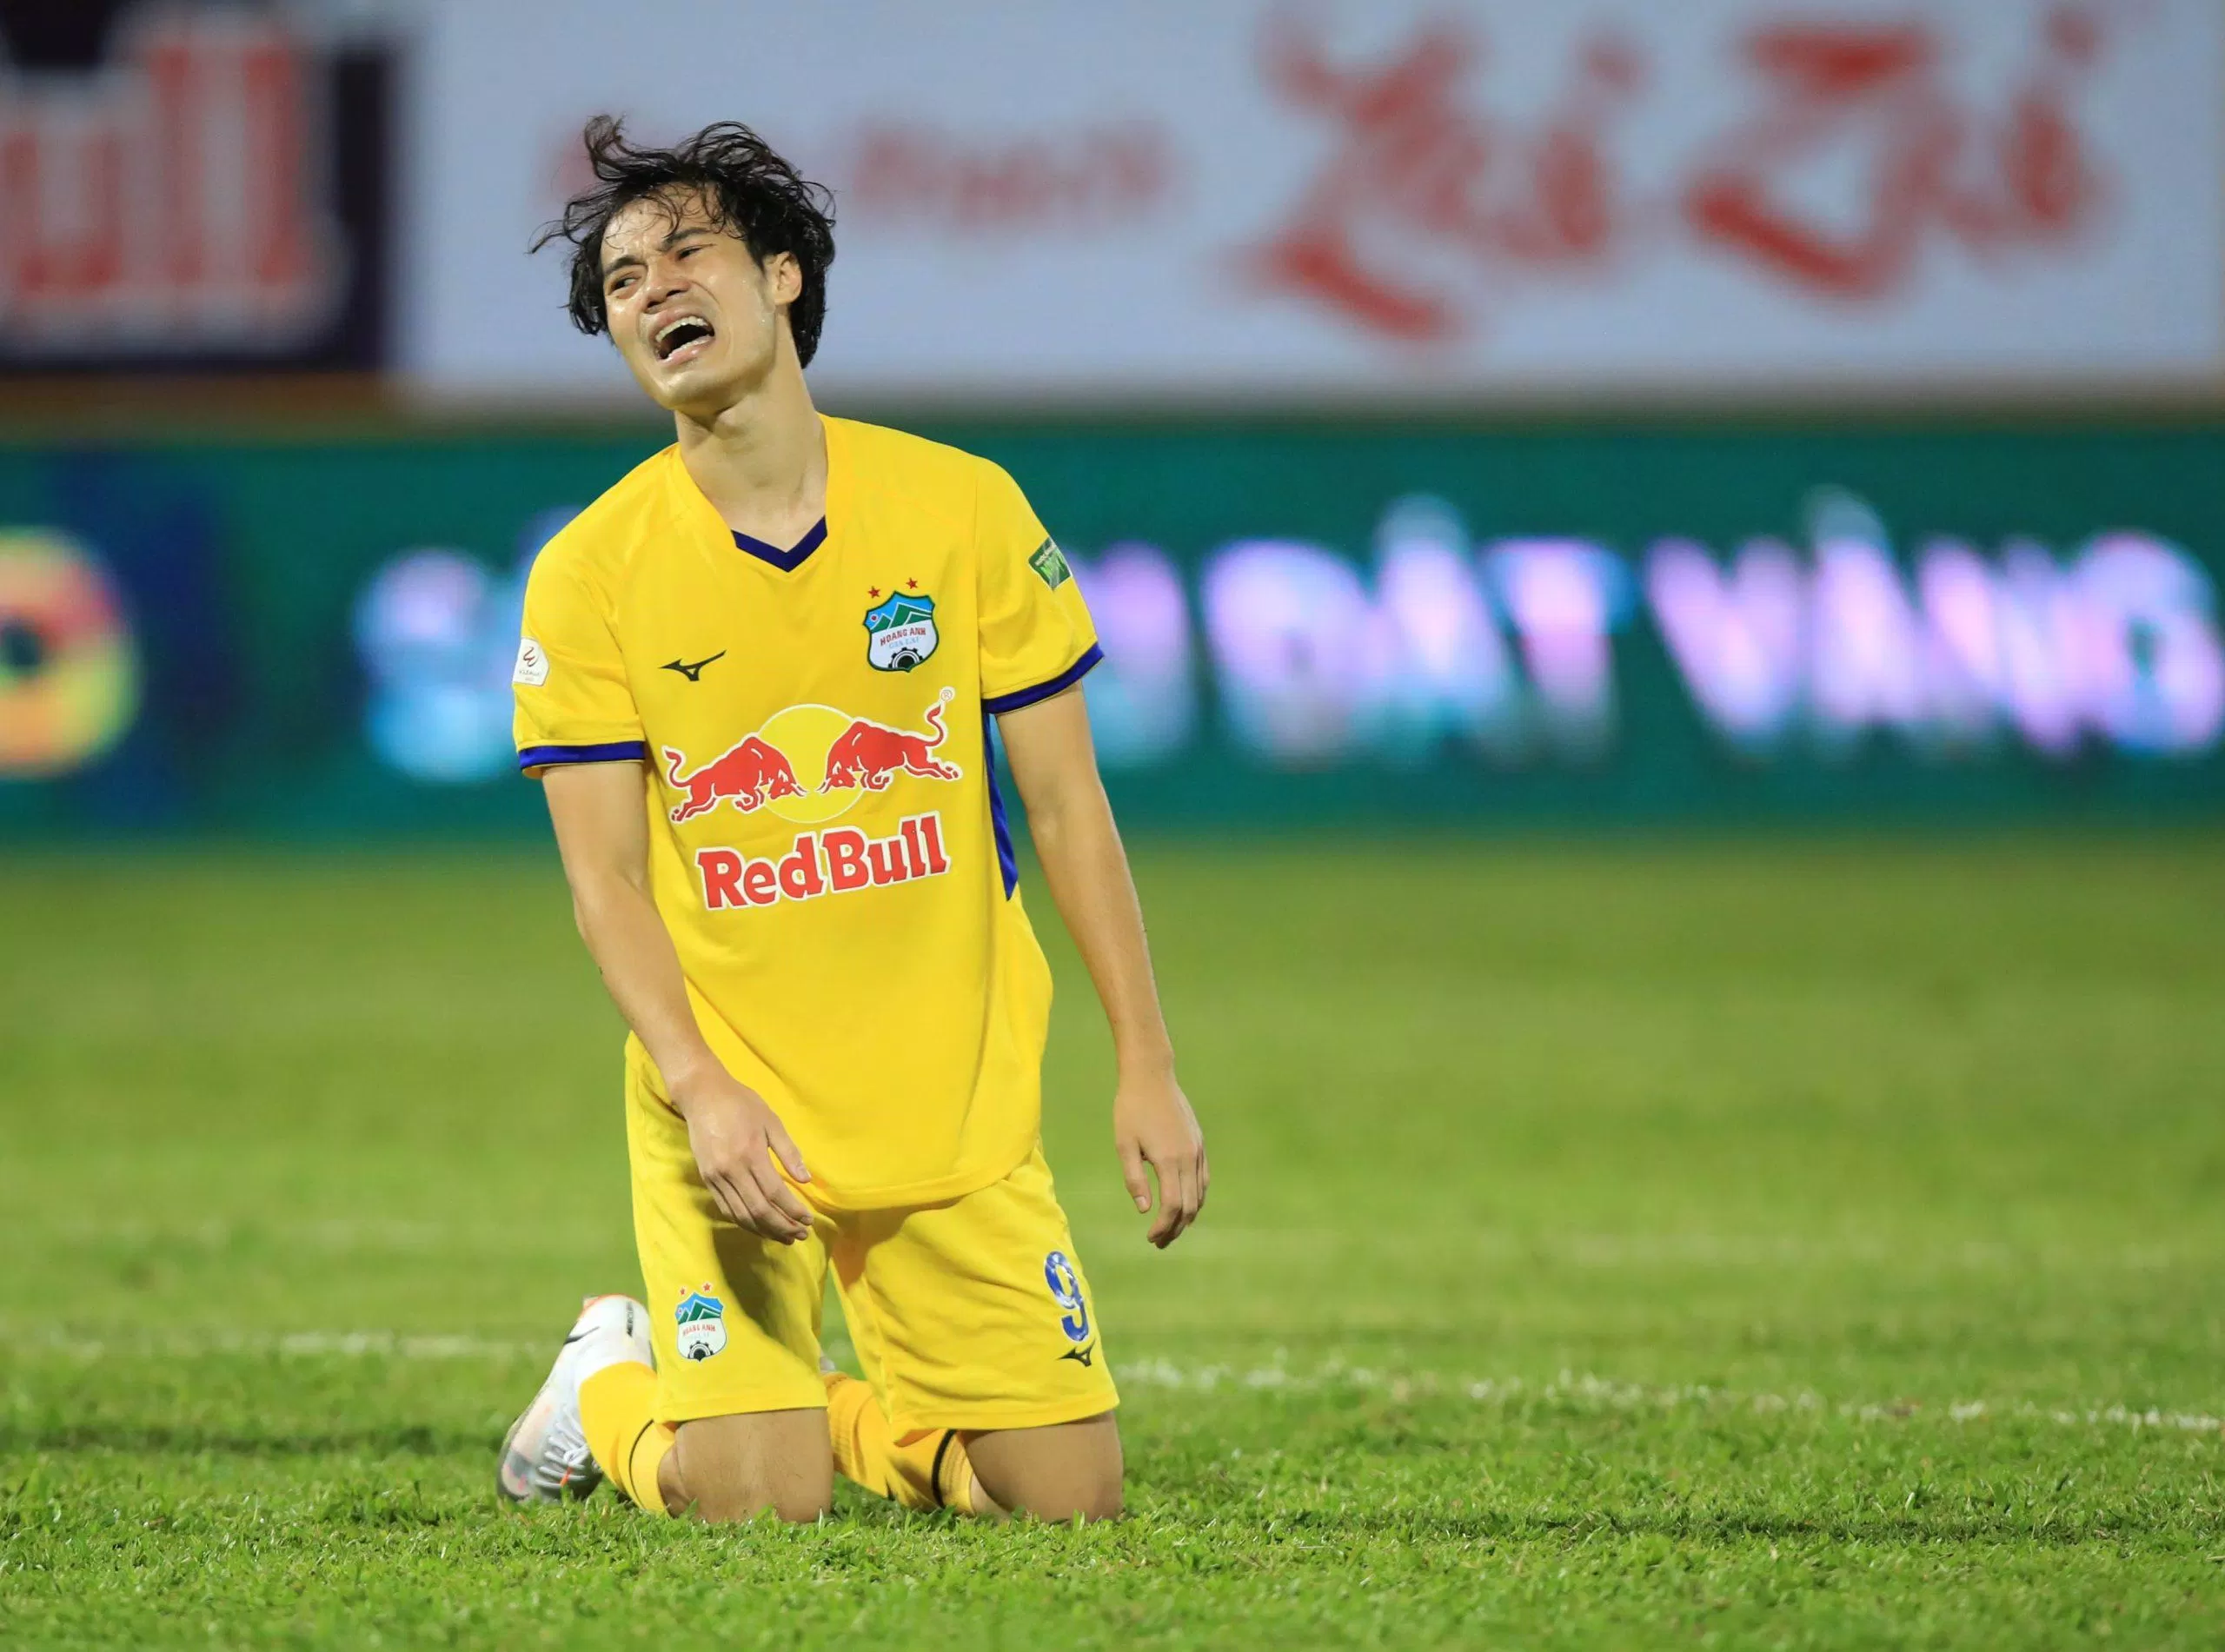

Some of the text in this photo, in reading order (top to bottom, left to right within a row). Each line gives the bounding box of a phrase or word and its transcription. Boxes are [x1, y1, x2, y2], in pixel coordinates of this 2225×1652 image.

[880, 627, 926, 646] HOANG ANH
[696, 812, 950, 910] Red Bull
[1045, 1251, 1089, 1343] 9
